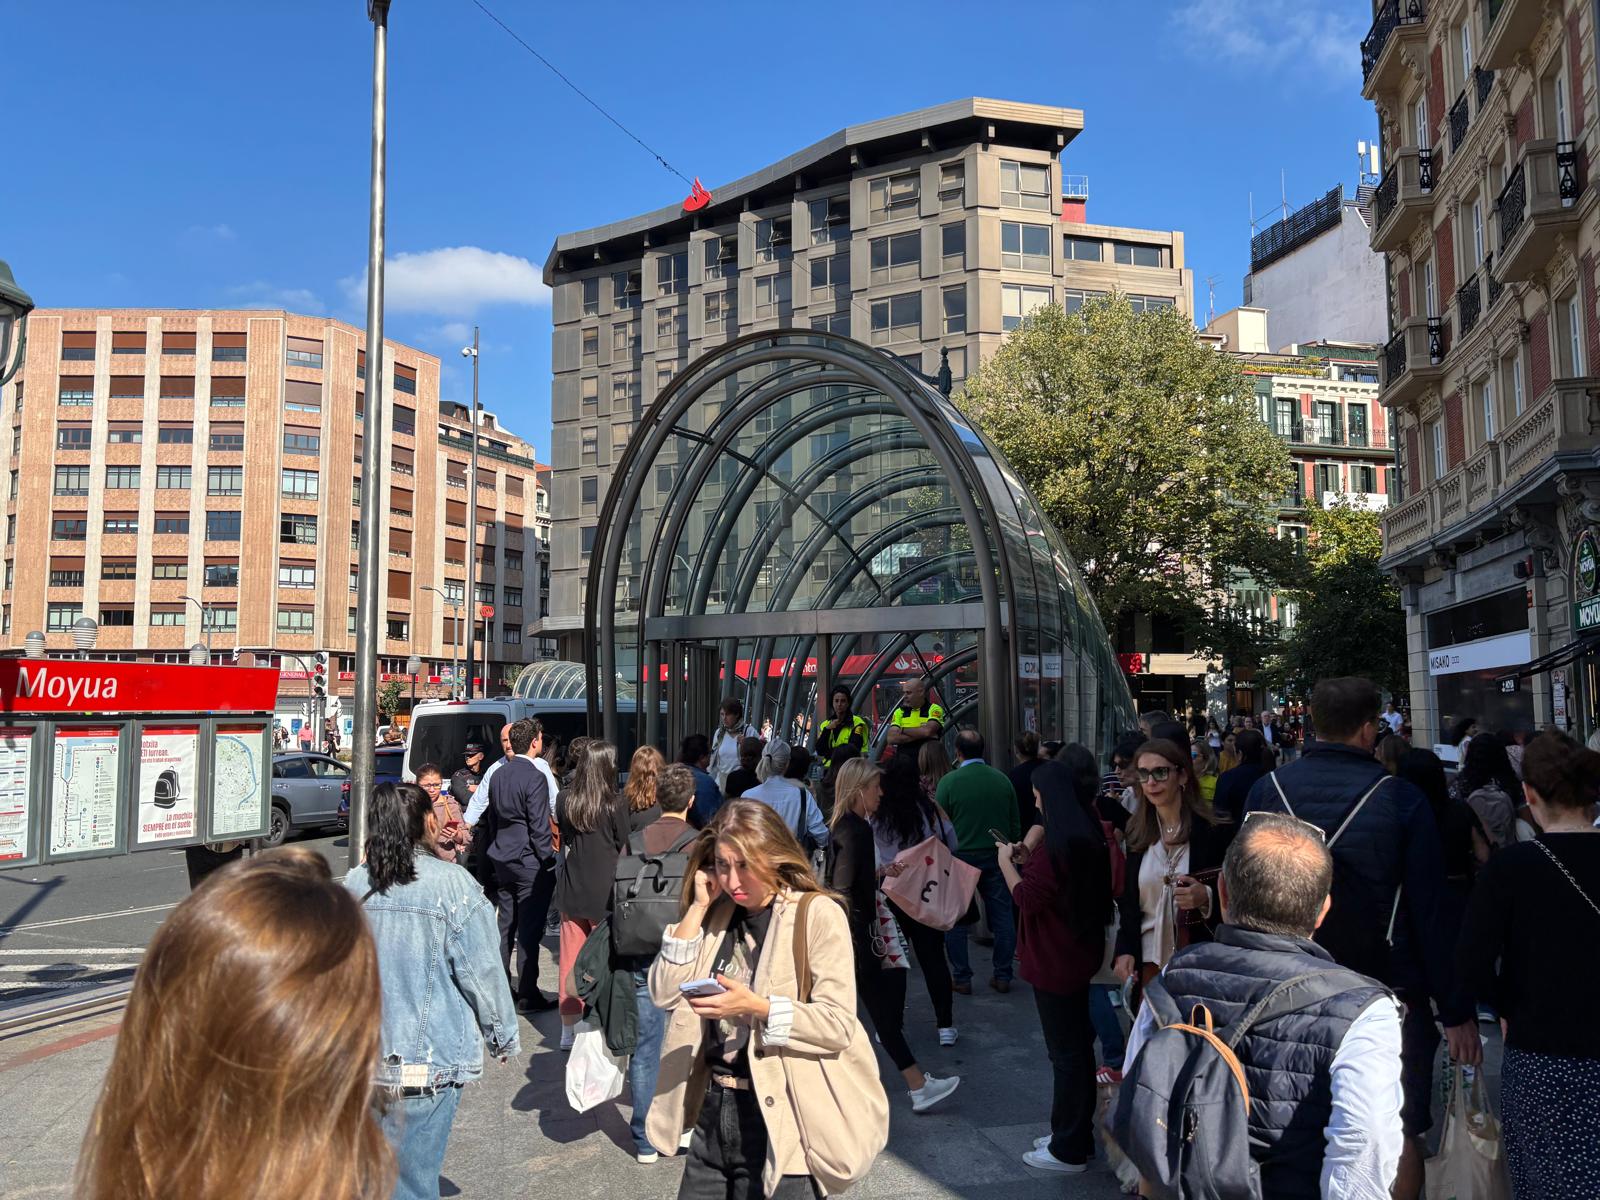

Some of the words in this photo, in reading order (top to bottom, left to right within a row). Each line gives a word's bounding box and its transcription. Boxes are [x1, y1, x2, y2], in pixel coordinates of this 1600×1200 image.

[1579, 603, 1600, 627] MOYU
[1430, 655, 1450, 670] MISAKO
[15, 666, 118, 706] Moyua
[143, 823, 164, 832] SIEMPRE
